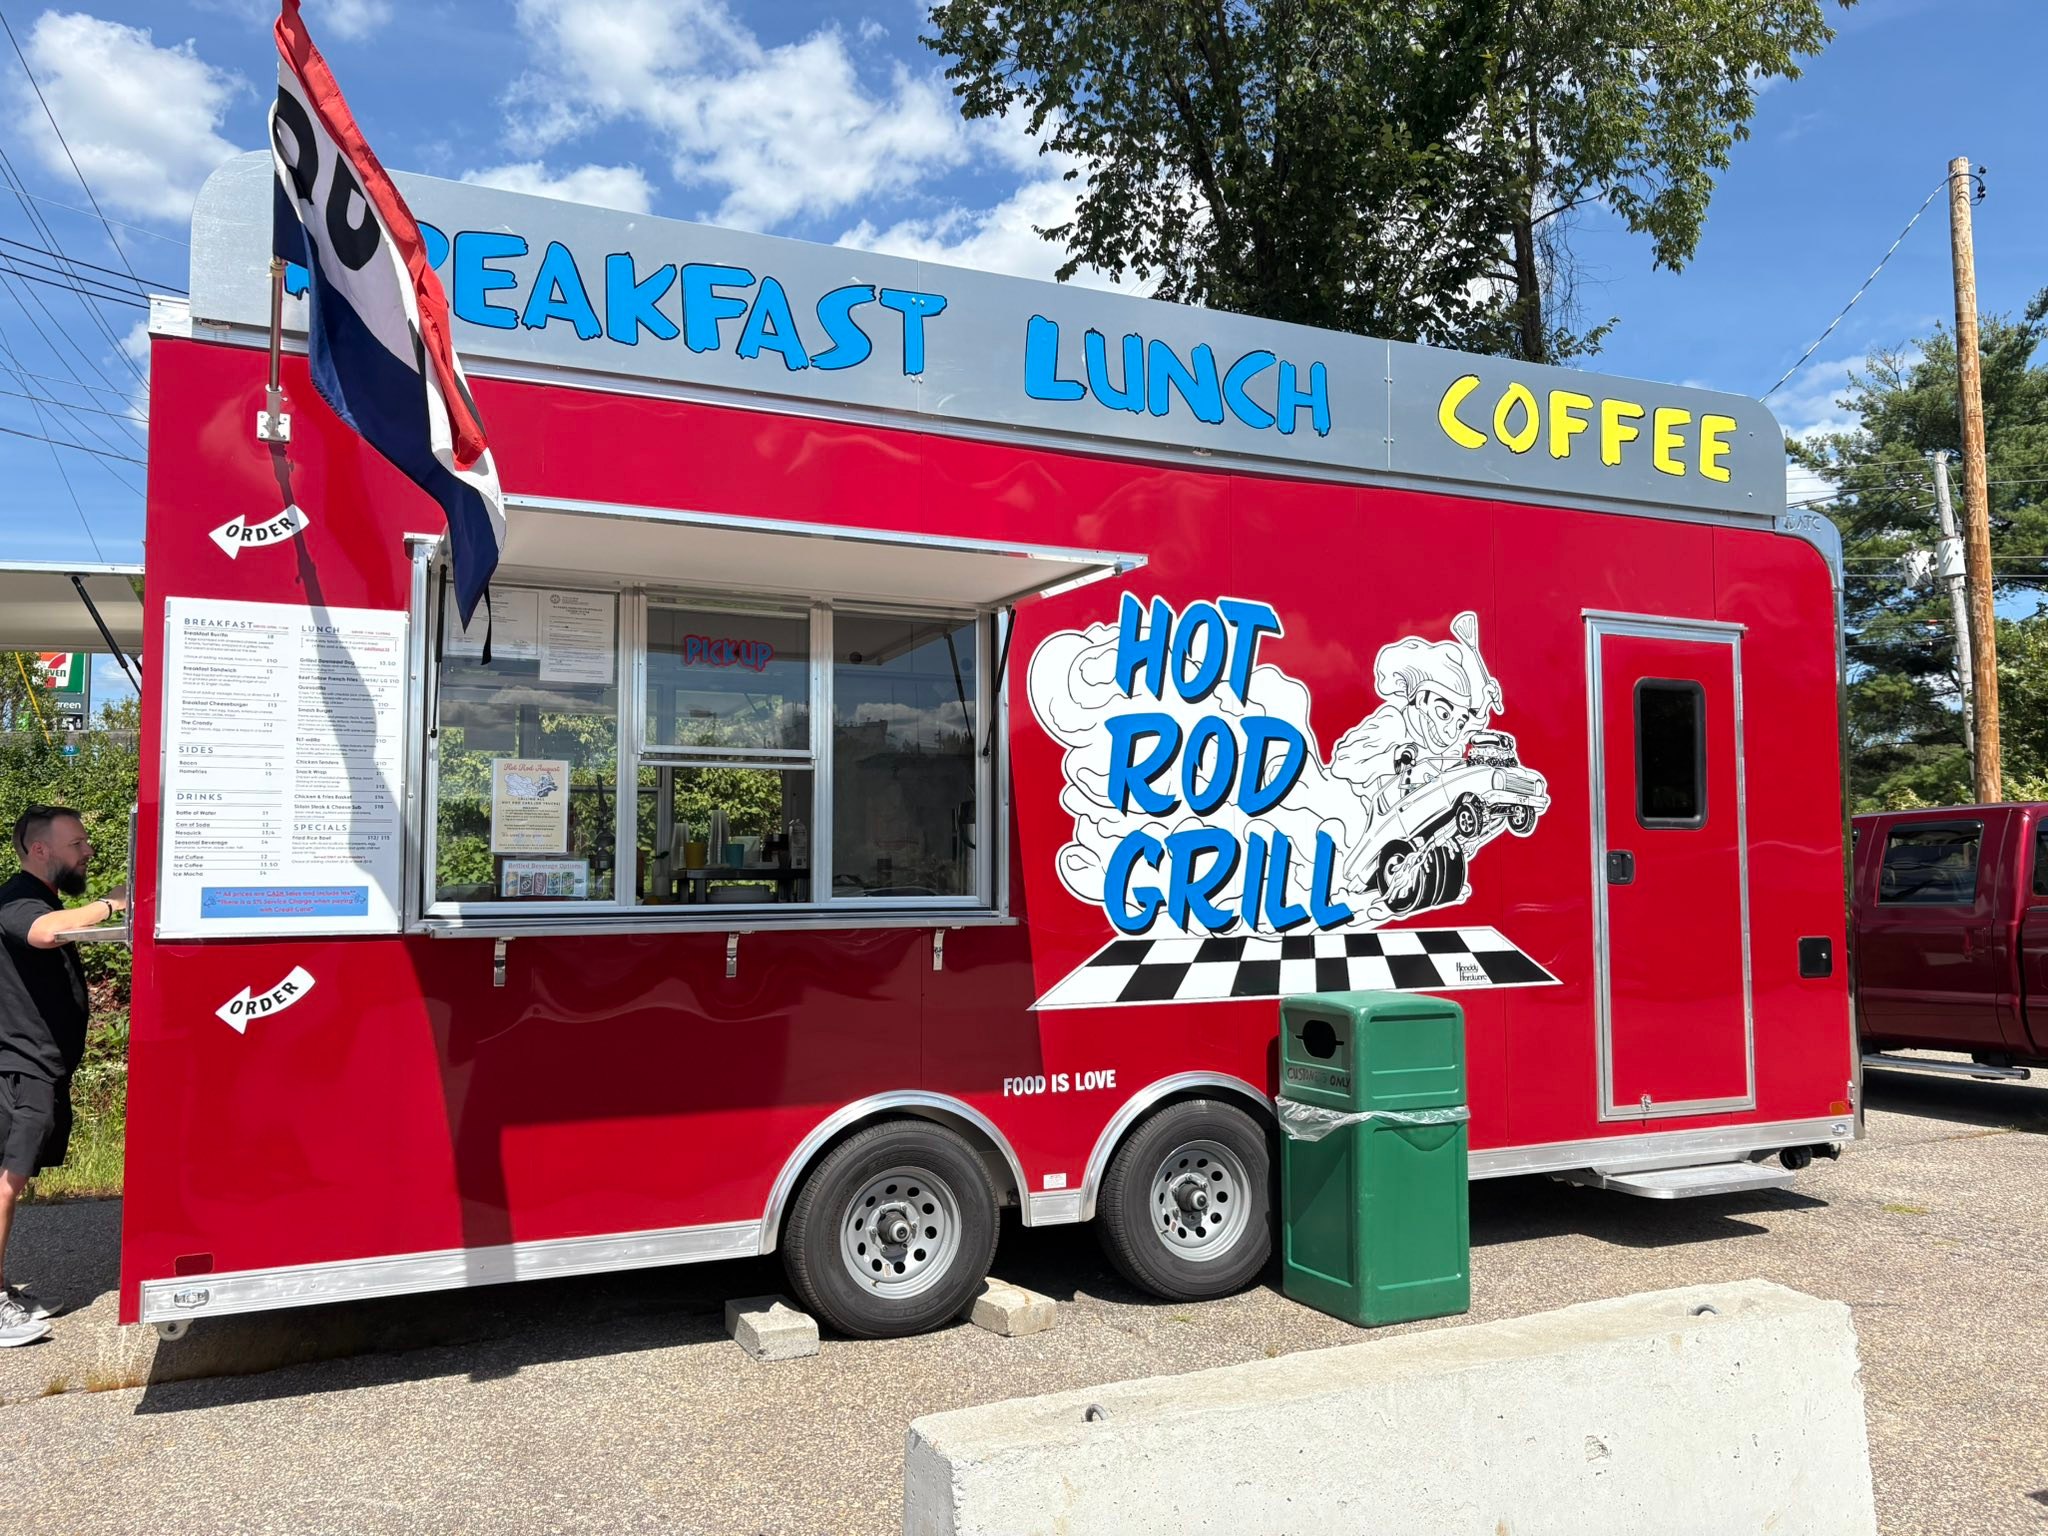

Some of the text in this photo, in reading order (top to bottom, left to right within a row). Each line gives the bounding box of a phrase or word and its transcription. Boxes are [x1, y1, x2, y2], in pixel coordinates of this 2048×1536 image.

[284, 220, 1738, 483] EAKFAST LUNCH COFFEE
[225, 517, 295, 541] ORDER
[184, 618, 254, 628] BREAKFAST
[301, 625, 340, 633] LUNCH
[1114, 591, 1285, 707] HOT
[1104, 713, 1308, 818] ROD
[1103, 828, 1355, 935] GRILL
[230, 982, 299, 1015] ORDER
[1004, 1070, 1116, 1096] FOOD IS LOVE
[1330, 1075, 1350, 1088] ONLY
